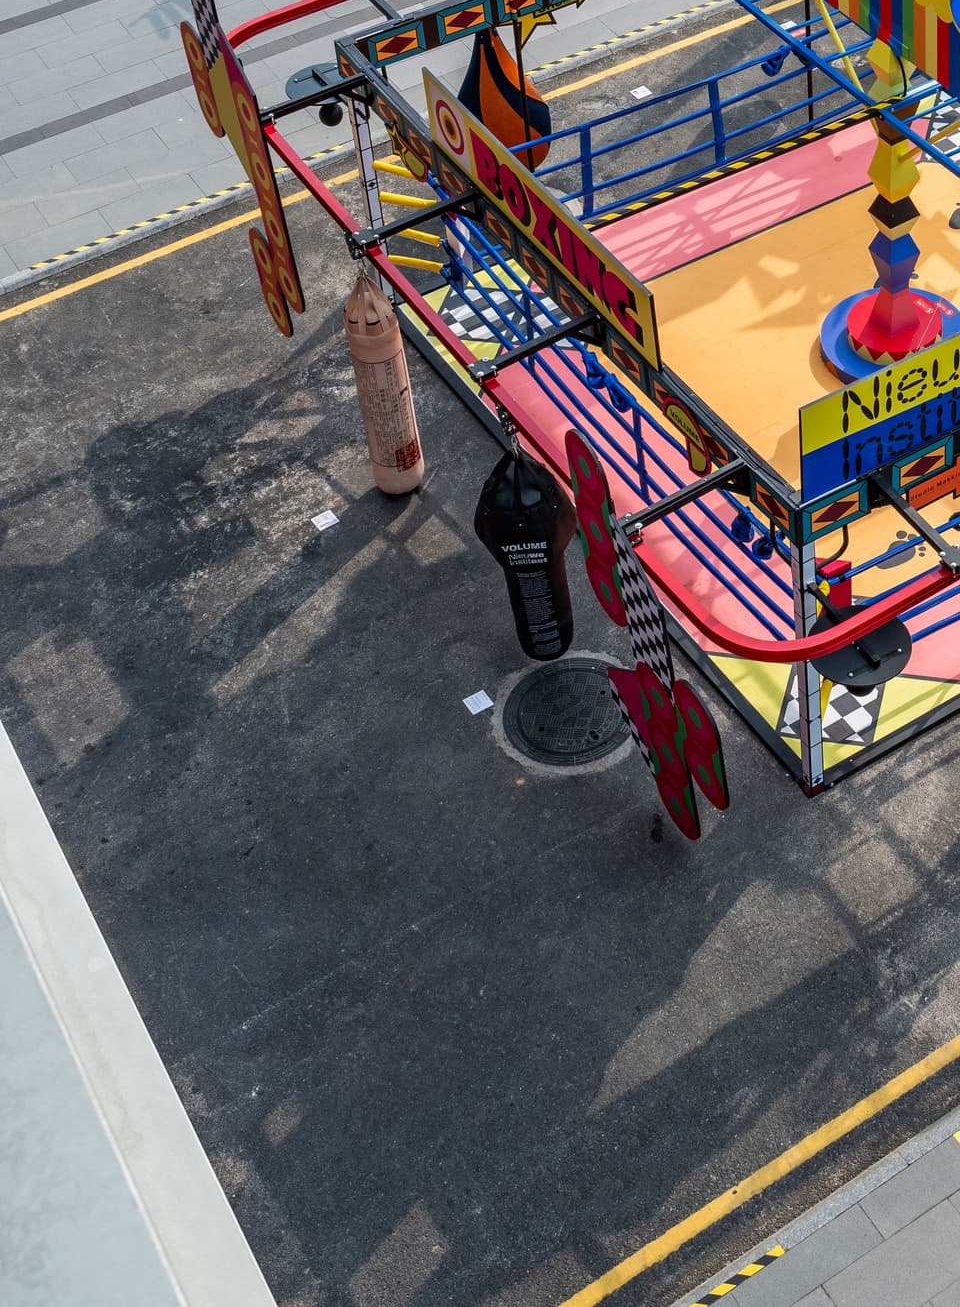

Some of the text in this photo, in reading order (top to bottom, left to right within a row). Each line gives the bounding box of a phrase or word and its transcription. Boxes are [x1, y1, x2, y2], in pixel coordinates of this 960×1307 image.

[469, 127, 645, 348] BOXING
[670, 407, 699, 441] VOLUME
[910, 485, 934, 502] Studio
[501, 541, 547, 552] VOLUME
[508, 552, 545, 561] Nieuwe
